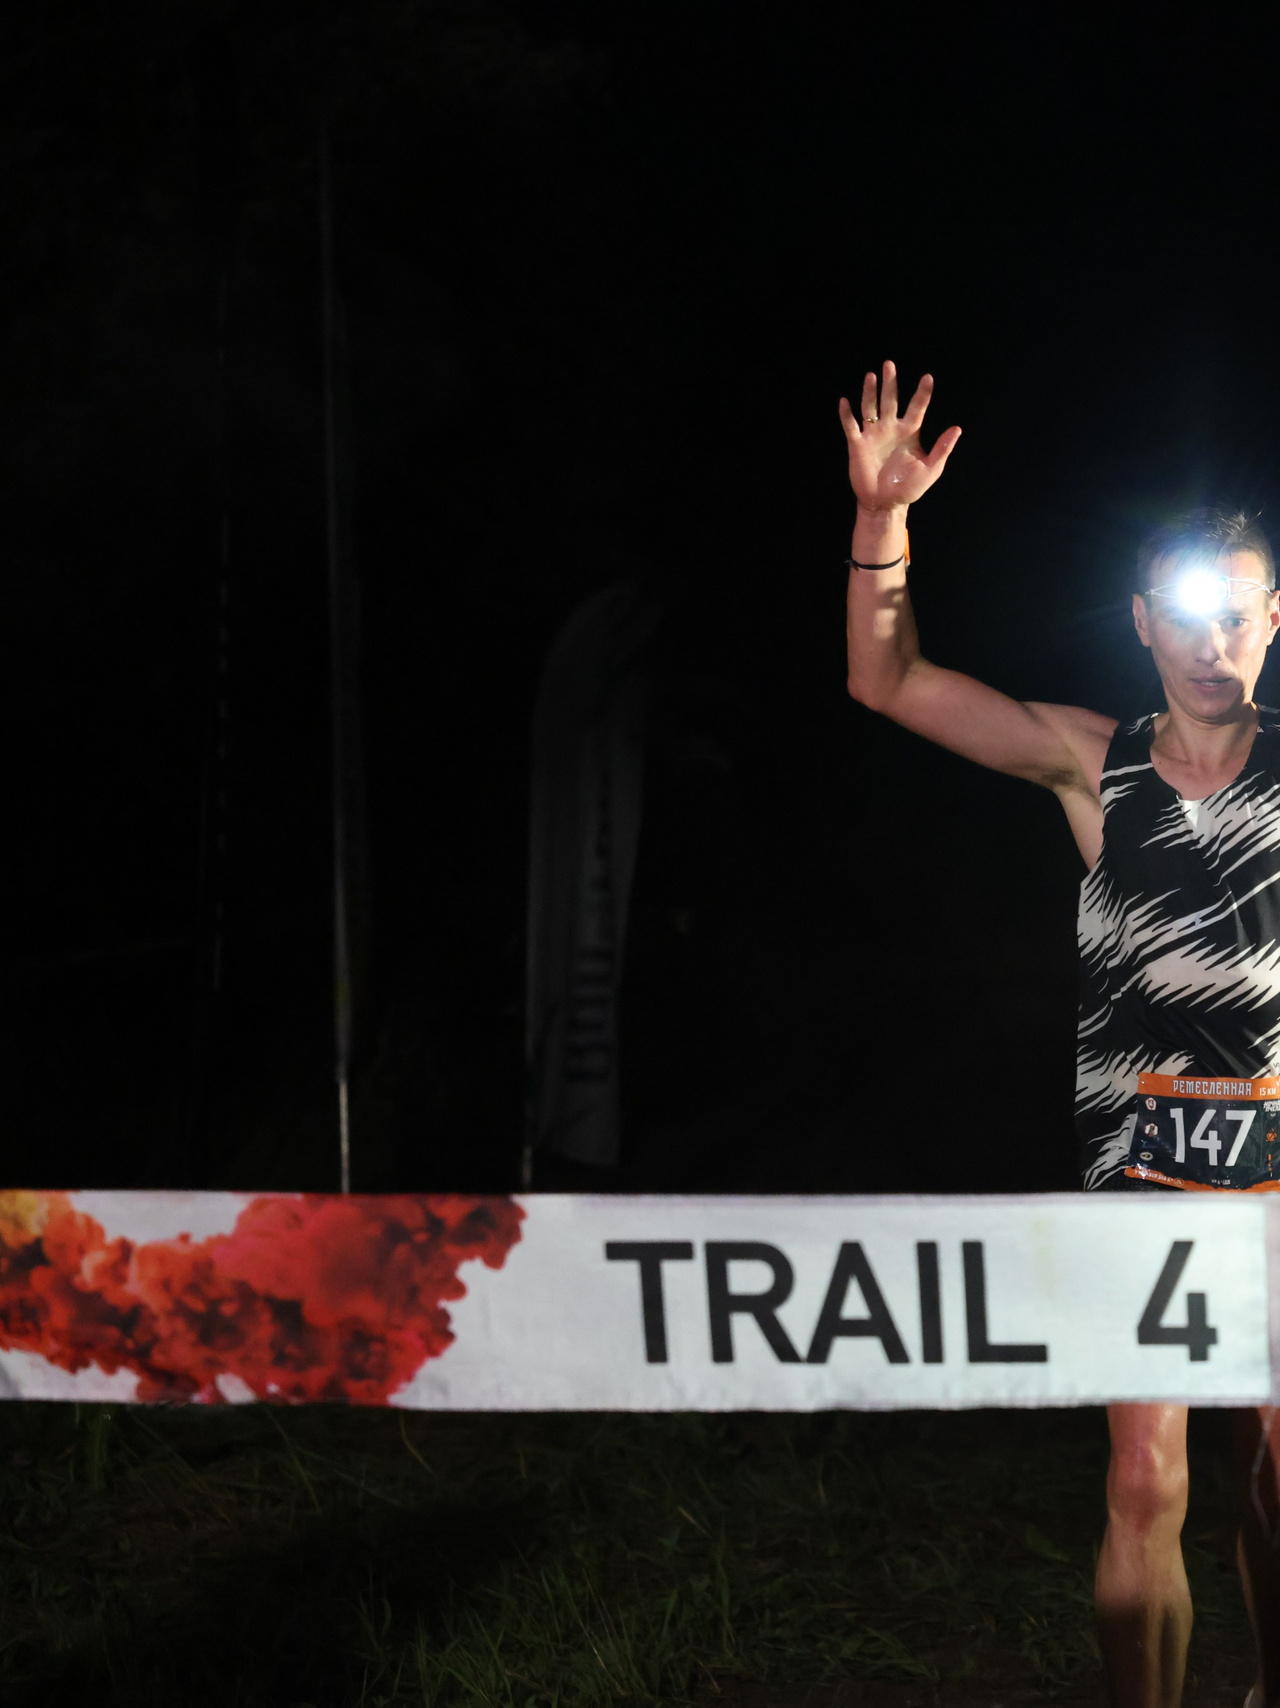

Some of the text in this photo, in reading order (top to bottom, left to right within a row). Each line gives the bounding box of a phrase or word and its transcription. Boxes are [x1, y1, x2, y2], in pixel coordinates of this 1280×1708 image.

[1173, 1079, 1252, 1096] РЕМЕСЛЕННАЯ
[1170, 1107, 1257, 1167] 147
[605, 1240, 1048, 1364] TRAIL
[1136, 1240, 1219, 1363] 4
